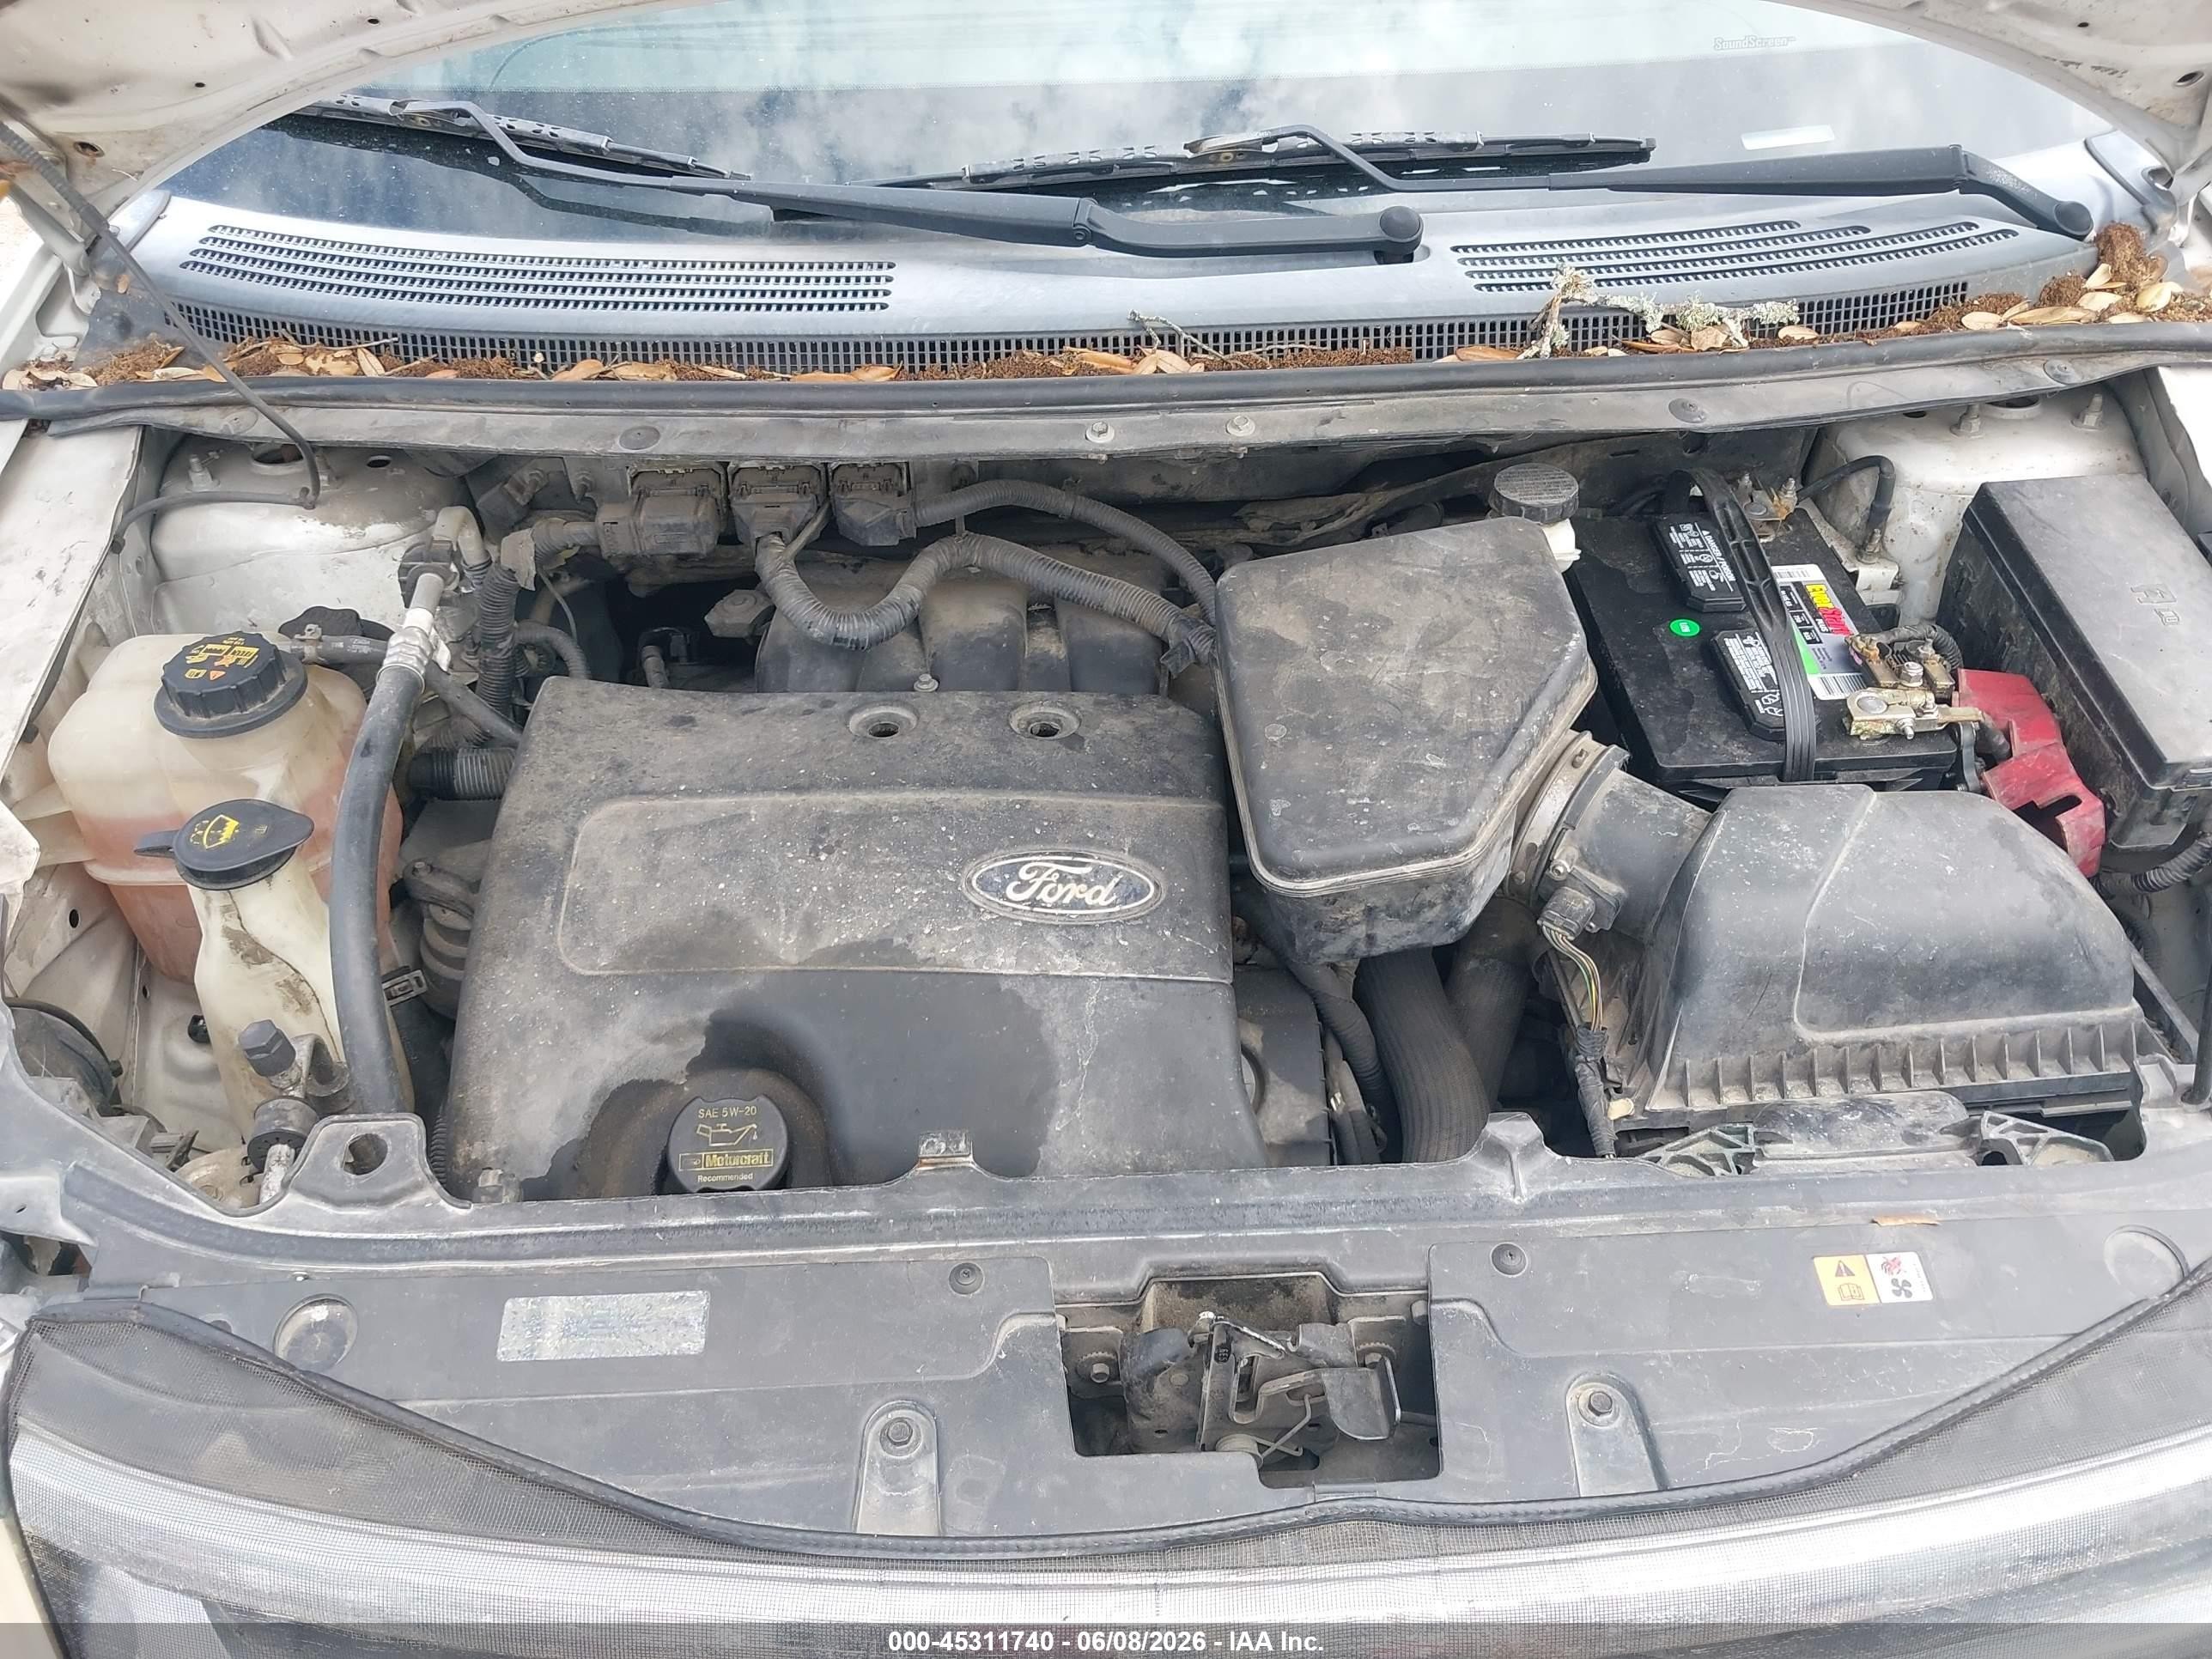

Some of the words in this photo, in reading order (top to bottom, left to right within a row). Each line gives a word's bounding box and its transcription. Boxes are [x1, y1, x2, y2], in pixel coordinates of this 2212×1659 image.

[1705, 535, 1723, 557] DANGER
[1718, 561, 1736, 582] POISON
[1815, 618, 1830, 633] PLUS
[1006, 861, 1123, 906] Ford
[698, 1108, 719, 1119] SAE
[721, 1105, 757, 1118] 5W-20
[705, 1152, 770, 1168] Motorcraft
[697, 1172, 754, 1183] Recommended
